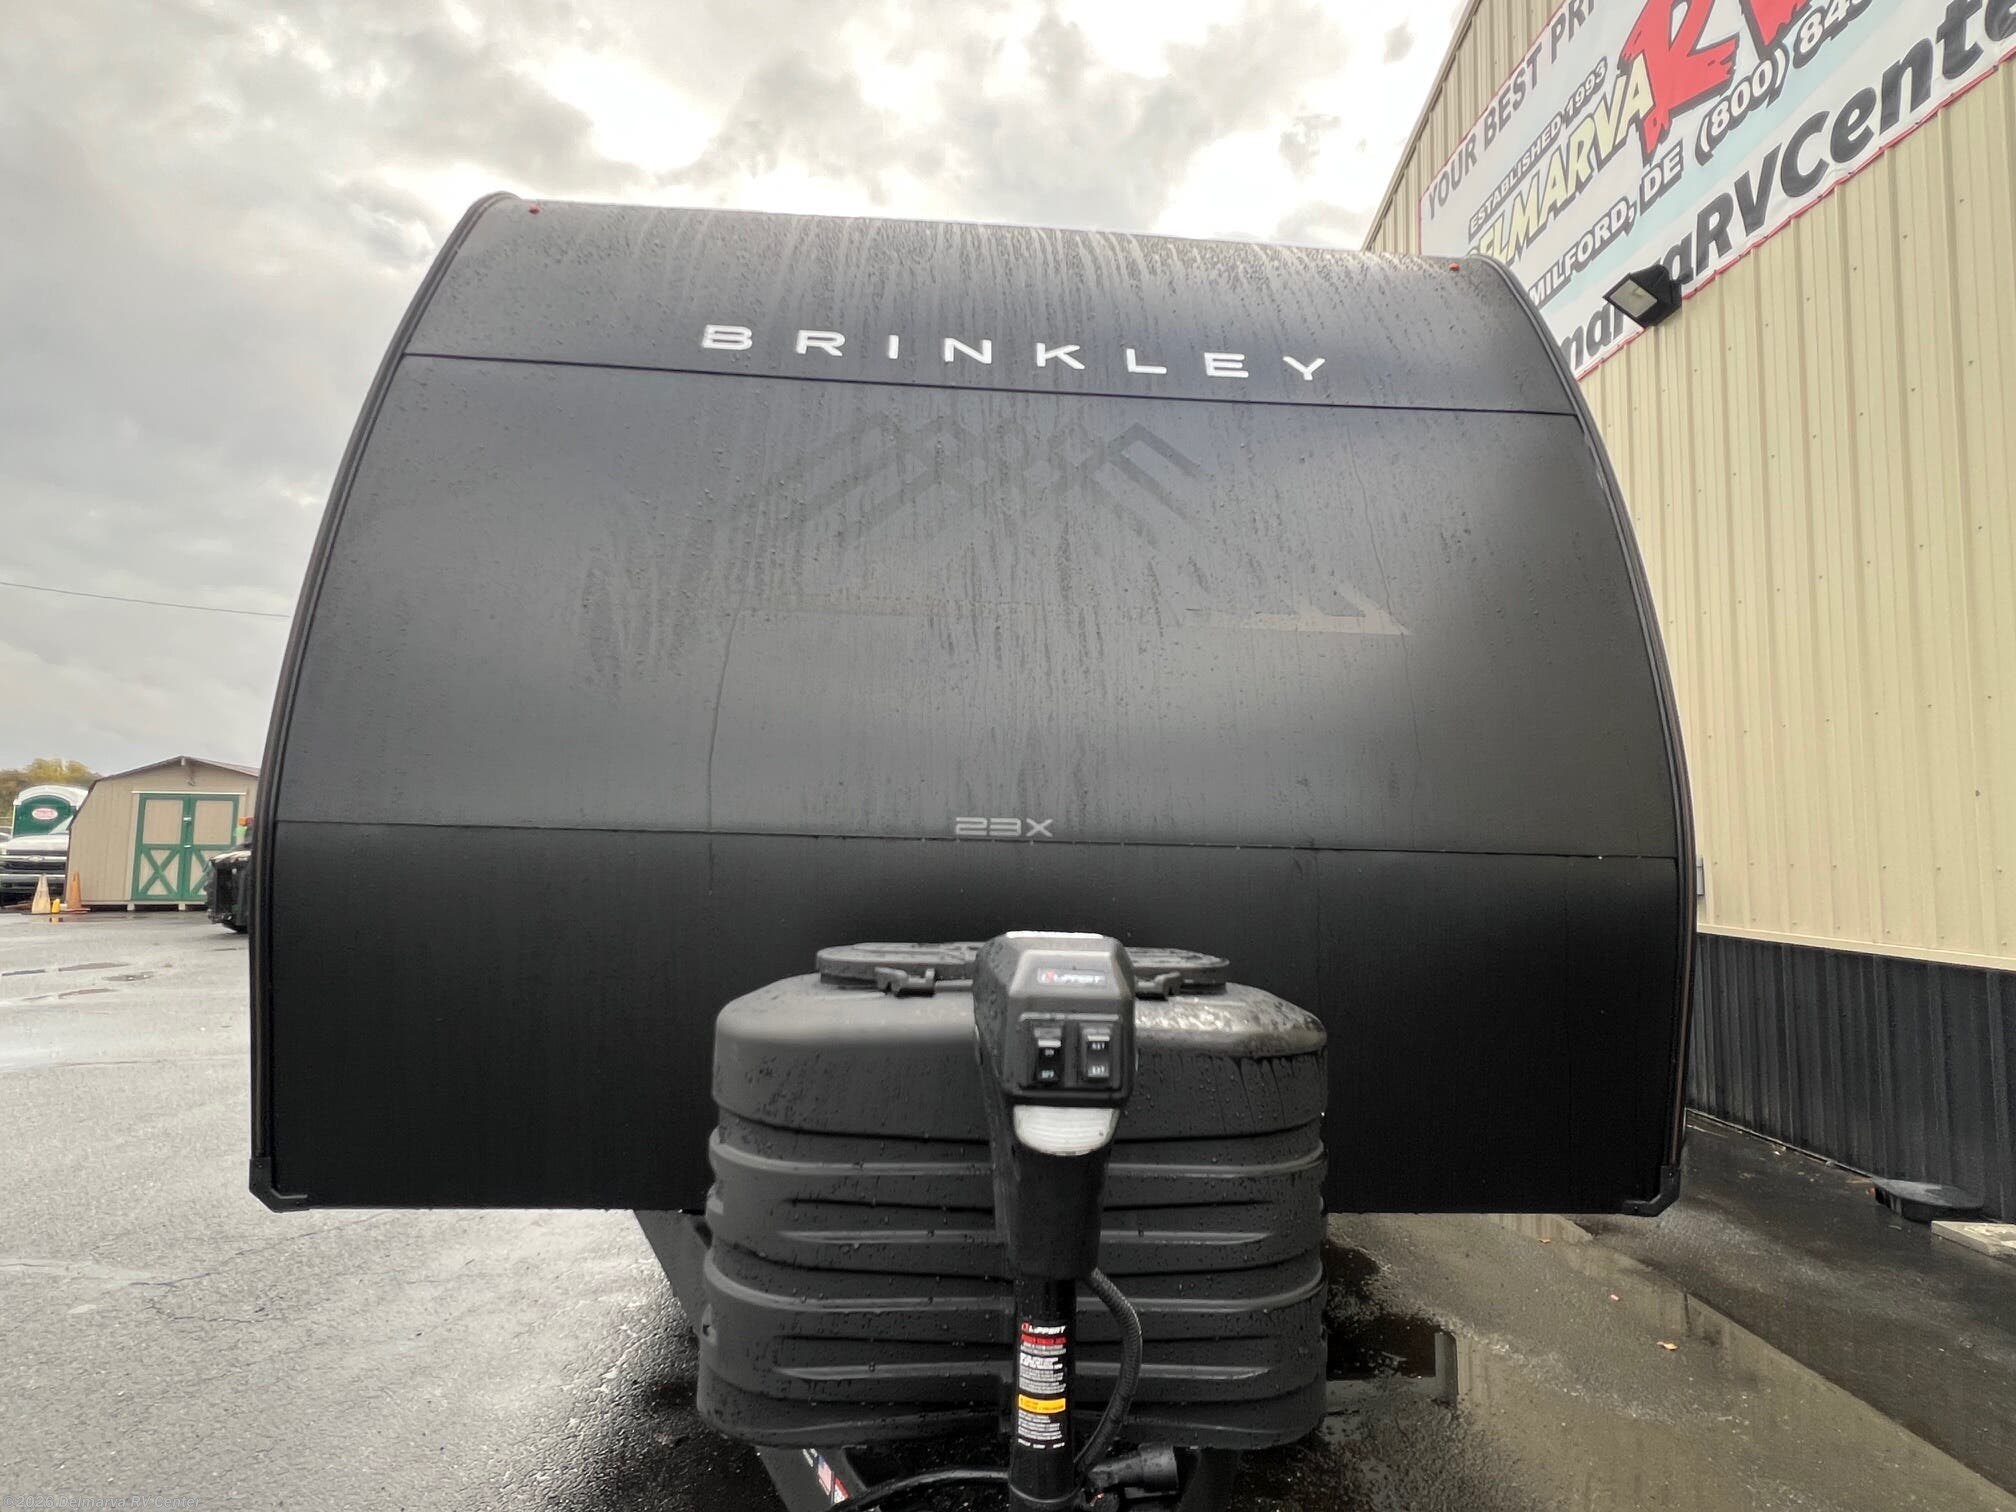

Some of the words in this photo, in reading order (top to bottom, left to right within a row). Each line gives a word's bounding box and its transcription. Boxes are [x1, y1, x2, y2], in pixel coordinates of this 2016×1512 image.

[1427, 132, 1478, 220] YOUR
[1484, 42, 1542, 151] BEST
[1469, 112, 1563, 240] ESTABLISHED
[1563, 57, 1608, 129] 1993
[1528, 196, 1637, 308] MILFORD,
[1641, 144, 1682, 210] DE
[1696, 45, 1789, 162] (800)
[702, 324, 1326, 381] BRINKLEY
